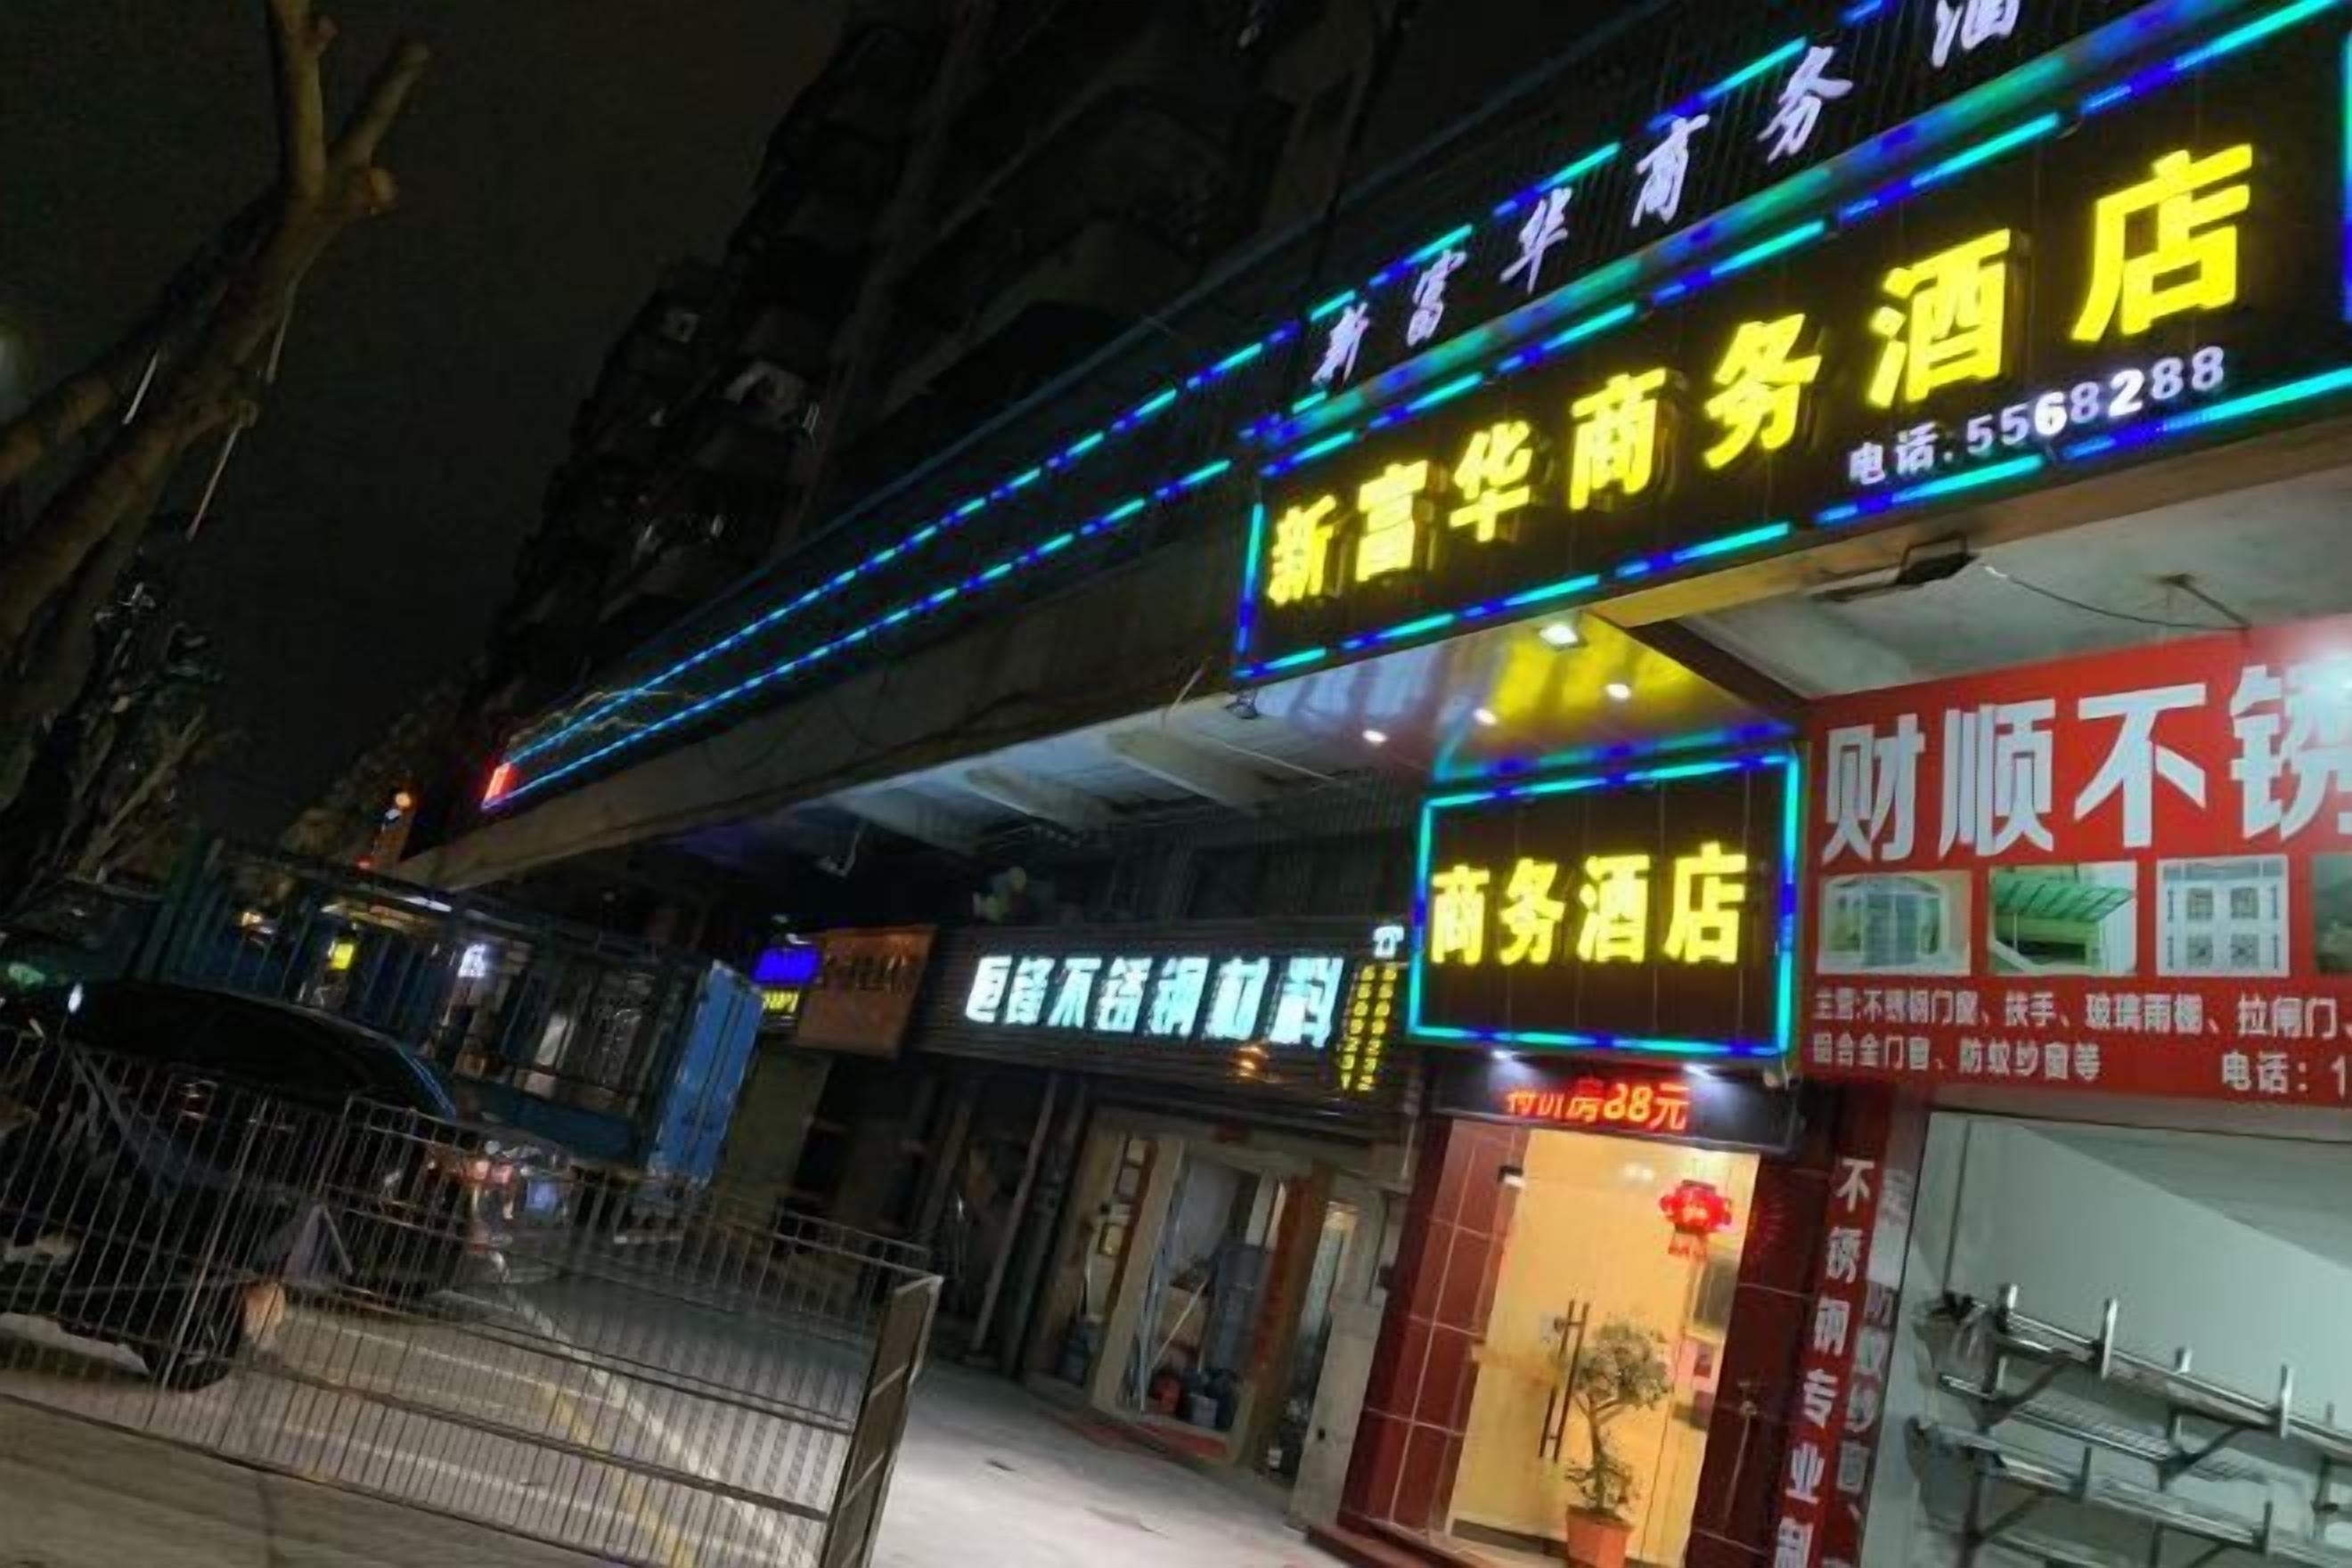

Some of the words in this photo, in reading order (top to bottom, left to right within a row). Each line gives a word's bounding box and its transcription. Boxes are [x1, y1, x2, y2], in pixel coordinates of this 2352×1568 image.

[1268, 143, 2253, 605] 新富华商务酒店
[1430, 840, 1749, 965] 商务酒店
